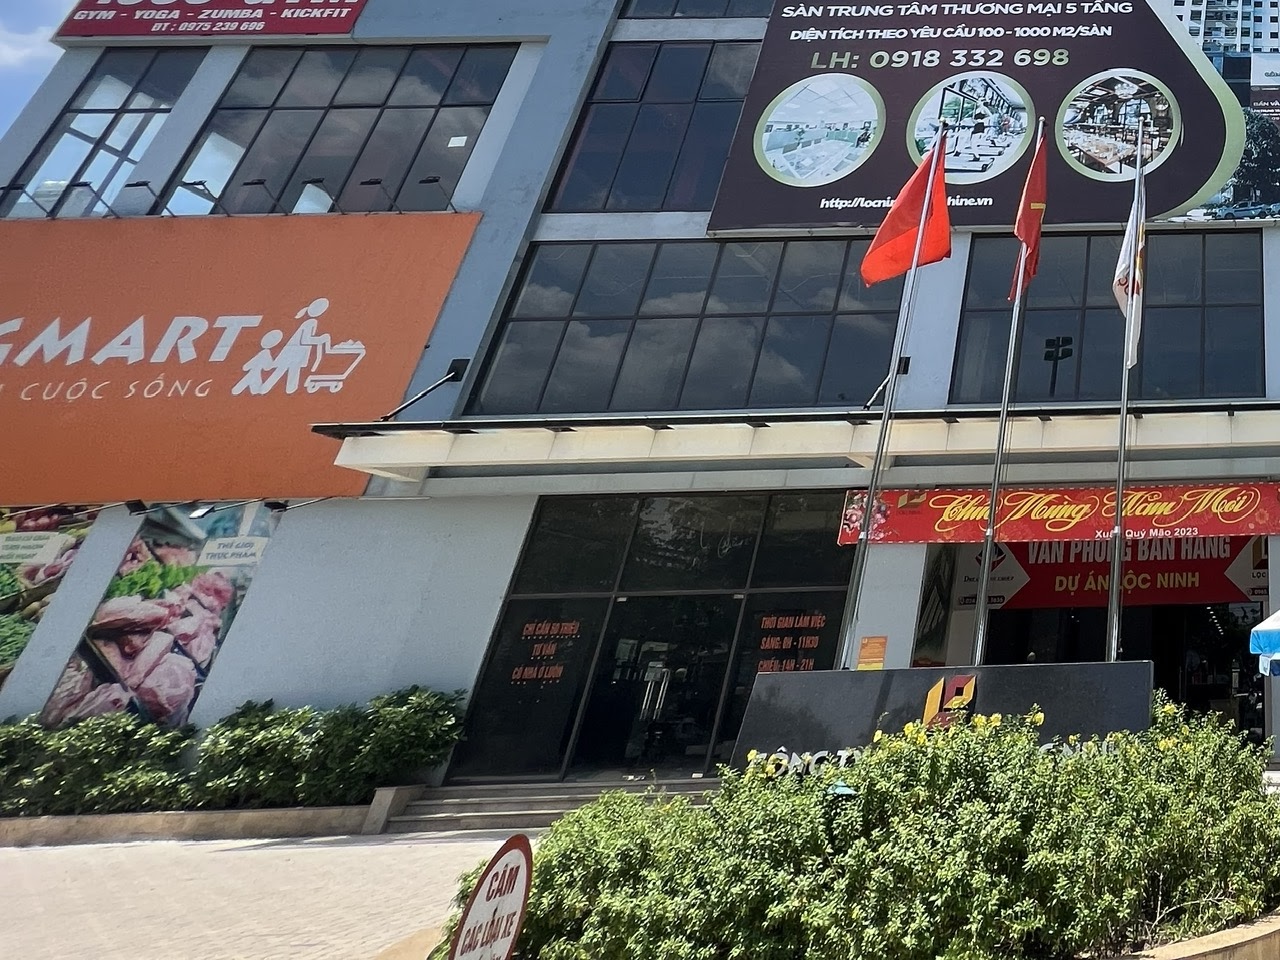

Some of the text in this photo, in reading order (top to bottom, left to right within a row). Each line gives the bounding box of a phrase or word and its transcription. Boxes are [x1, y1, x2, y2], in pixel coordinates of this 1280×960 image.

[73, 10, 114, 21] GYM
[134, 9, 181, 20] YOGA
[197, 8, 264, 19] ZUMBA
[280, 7, 352, 19] KICKFIT
[781, 4, 823, 18] SÀN
[826, 5, 894, 17] TRUNG
[898, 1, 937, 16] TÂM
[941, 2, 1024, 15] THƯƠNG
[1026, 2, 1062, 17] MẠI
[1065, 2, 1077, 14] 5
[178, 22, 211, 31] 0975
[211, 21, 238, 31] 239
[240, 21, 266, 31] 696
[789, 27, 828, 43] DIỆN
[829, 27, 865, 40] TÍCH
[866, 29, 908, 39] THEO
[910, 26, 942, 39] YÊU
[978, 27, 1005, 38] 100
[1014, 26, 1051, 37] 1000
[1052, 24, 1113, 38] M2/SÀN
[811, 48, 1070, 69] LH: 0918 332 698
[820, 196, 993, 210] http://locnihine.vn
[20, 372, 213, 403] CUỘC SỐNG
[1125, 530, 1147, 540] Quý
[1149, 528, 1172, 538] Mão
[1174, 527, 1199, 537] 2023
[1055, 569, 1200, 596] DỰ ÁN ỘC NINH
